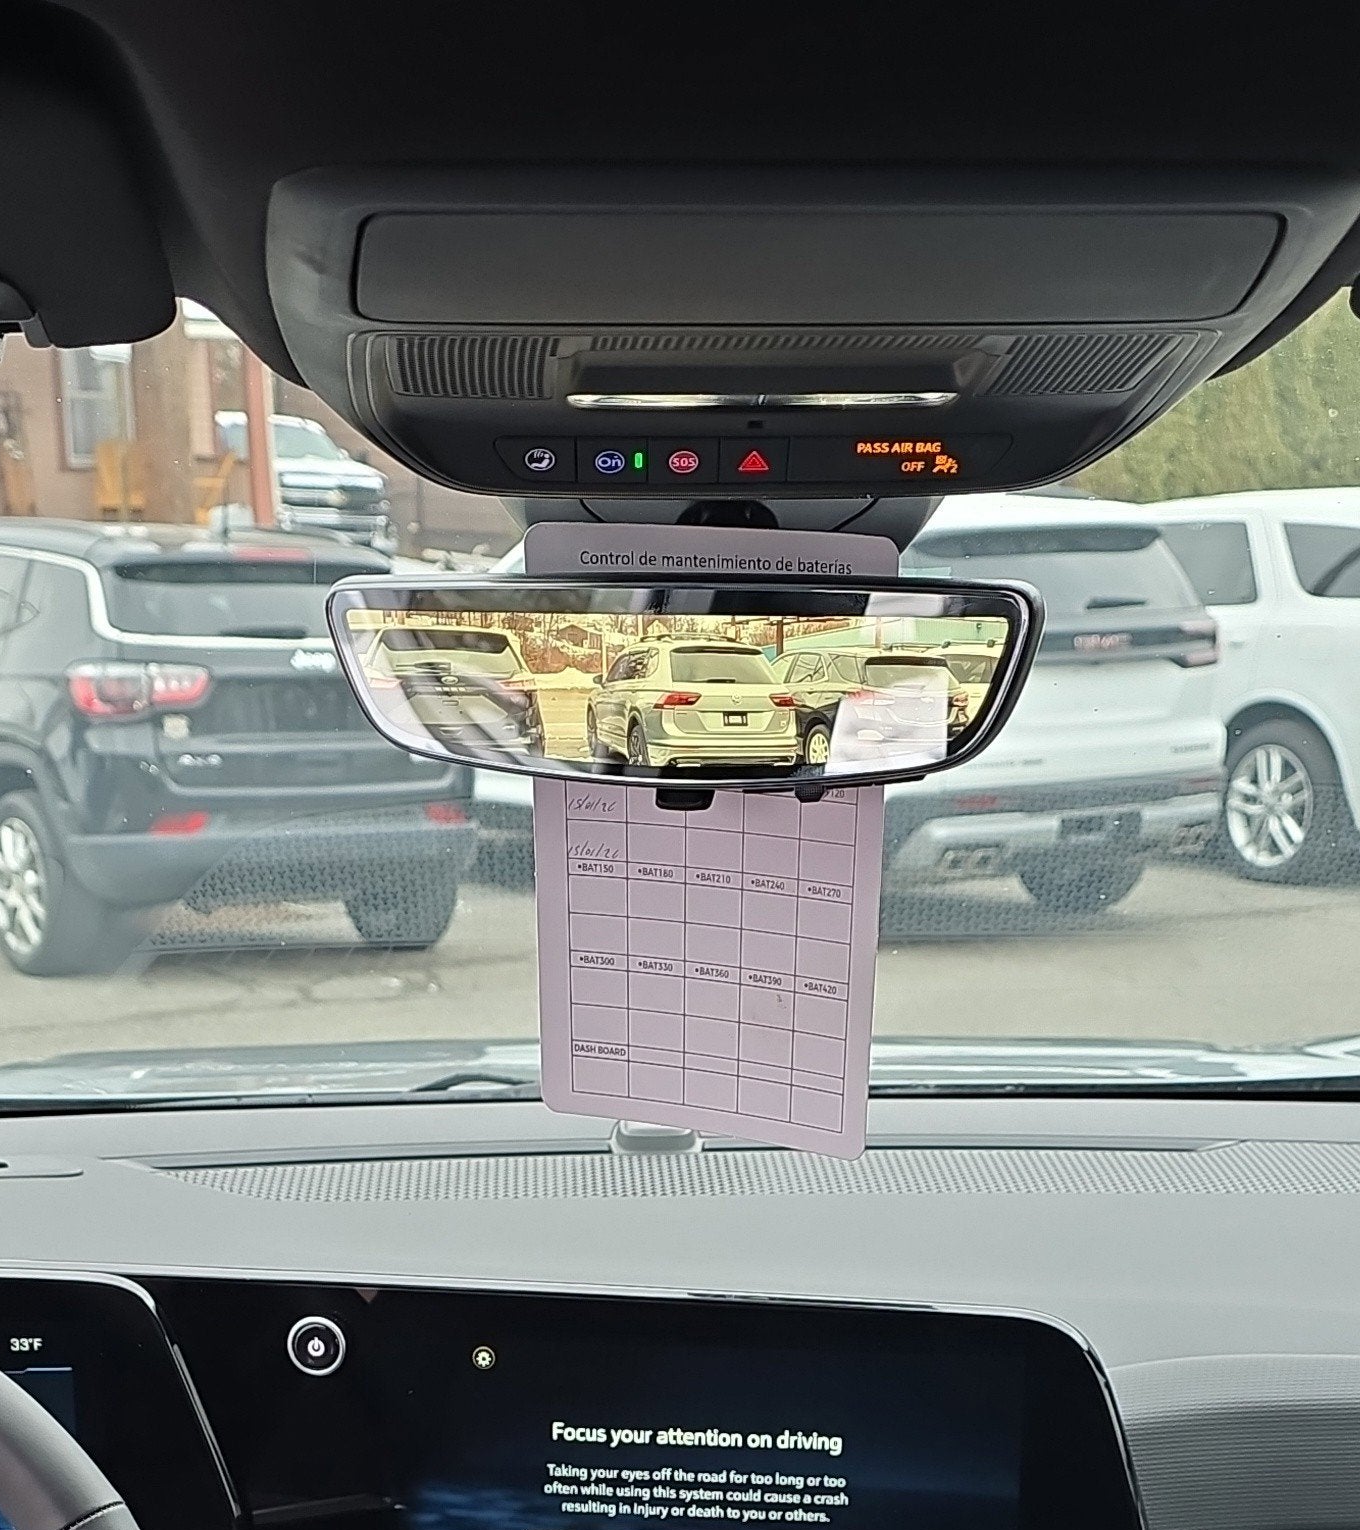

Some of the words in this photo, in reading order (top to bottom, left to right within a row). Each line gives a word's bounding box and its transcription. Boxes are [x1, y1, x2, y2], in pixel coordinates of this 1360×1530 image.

[856, 442, 889, 454] PASS
[892, 442, 914, 453] AIR
[915, 441, 942, 453] BAG
[671, 457, 697, 468] SOS
[901, 461, 926, 473] OFF
[580, 551, 635, 566] Control
[639, 552, 658, 567] de
[661, 552, 771, 571] mantenimiento
[774, 556, 794, 572] de
[798, 557, 853, 576] baterías
[574, 1043, 597, 1054] DASH
[597, 1045, 627, 1057] BOARD
[551, 1421, 607, 1443] Focus
[610, 1428, 653, 1448] your
[655, 1427, 743, 1447] attention
[746, 1432, 772, 1448] on
[776, 1429, 843, 1456] driving
[546, 1463, 588, 1481] Taking
[590, 1468, 619, 1481] your
[620, 1469, 650, 1483] eyes
[652, 1467, 672, 1481] off
[673, 1469, 695, 1482] the
[696, 1469, 727, 1484] road
[729, 1470, 749, 1484] for
[750, 1472, 773, 1485] too
[774, 1471, 805, 1489] long
[806, 1475, 822, 1487] or
[823, 1474, 847, 1488] too
[543, 1481, 579, 1495] often
[580, 1483, 614, 1496] while
[615, 1484, 651, 1501] using
[652, 1485, 677, 1499] this
[678, 1487, 723, 1503] system
[725, 1488, 762, 1502] could
[763, 1491, 801, 1504] cause
[802, 1493, 812, 1504] a
[813, 1492, 849, 1506] crash
[561, 1500, 617, 1518] resulting
[618, 1502, 631, 1515] in
[633, 1502, 669, 1519] injury
[670, 1506, 685, 1517] or
[687, 1504, 725, 1518] death
[726, 1506, 741, 1519] to
[742, 1508, 766, 1523] you
[768, 1509, 783, 1520] or
[784, 1508, 831, 1523] others.
